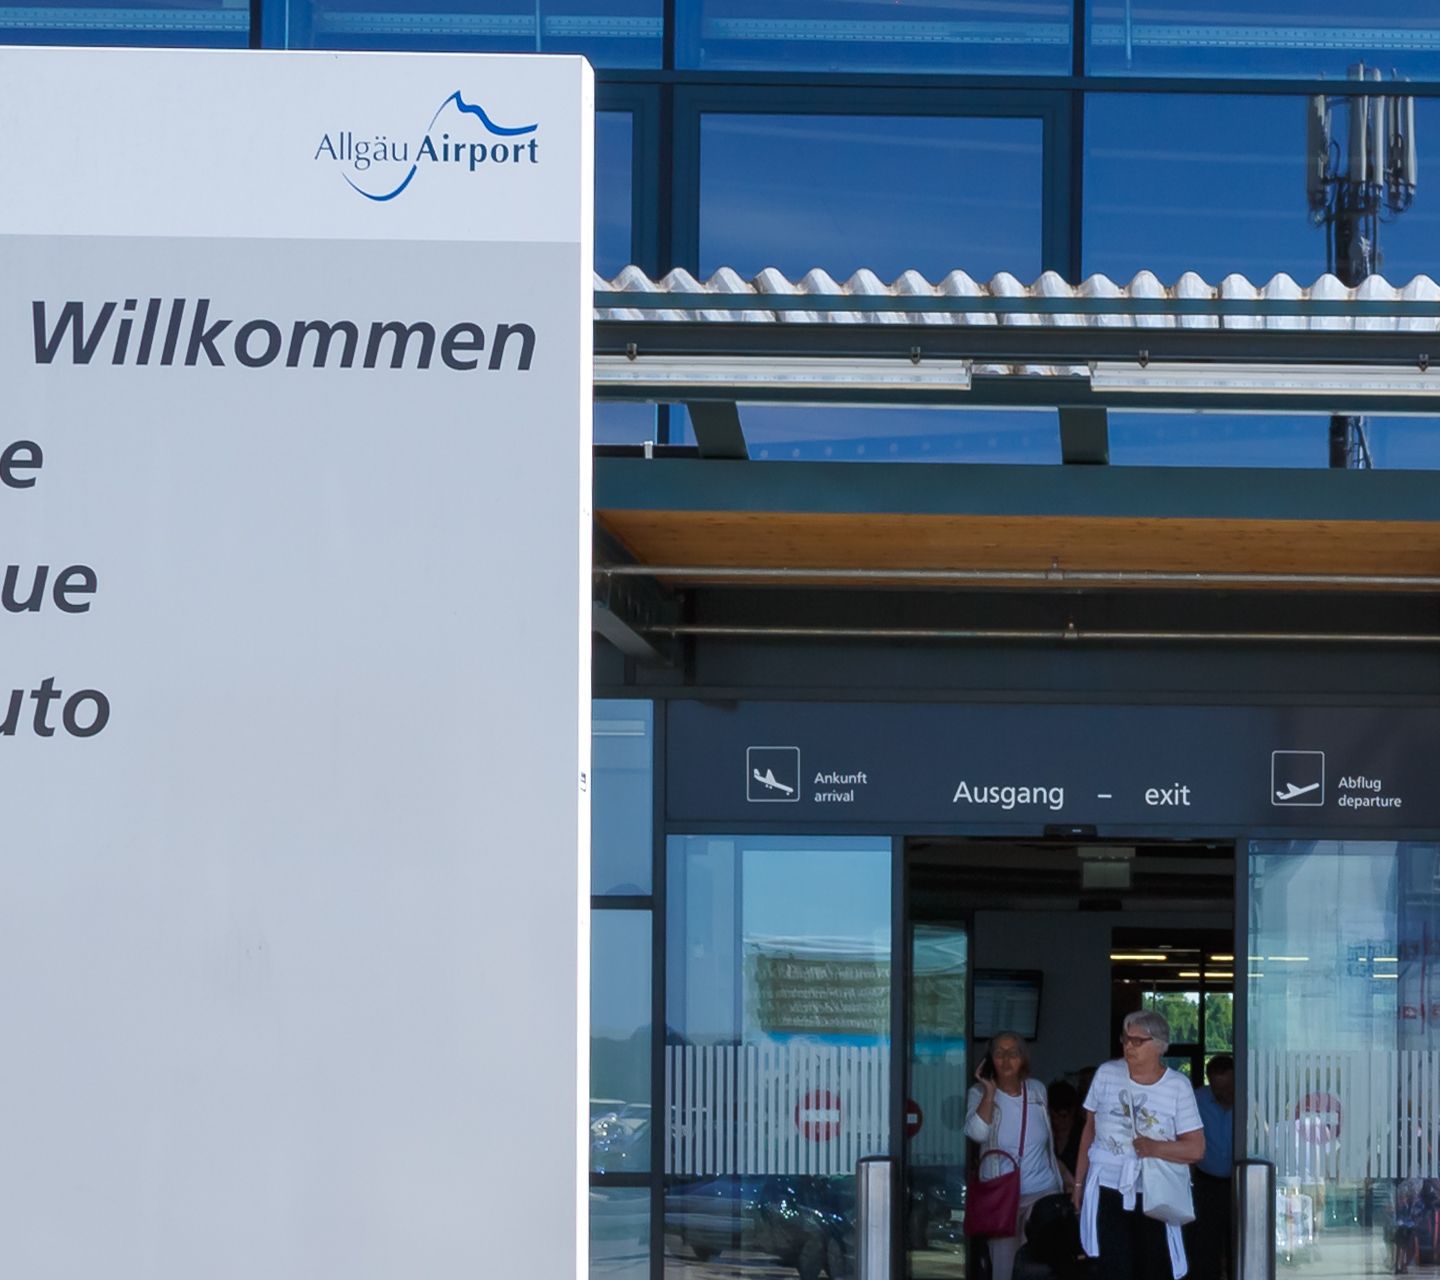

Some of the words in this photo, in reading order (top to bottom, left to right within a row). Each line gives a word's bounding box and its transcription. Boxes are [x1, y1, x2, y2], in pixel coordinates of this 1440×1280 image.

[314, 131, 409, 171] Allgäu
[415, 132, 540, 172] Airport
[31, 297, 536, 371] Willkommen
[814, 771, 868, 785] Ankunft
[1338, 776, 1382, 792] Abflug
[814, 789, 854, 802] arrival
[952, 781, 1064, 811] Ausgang
[1145, 782, 1191, 806] exit
[1338, 795, 1402, 810] departure
